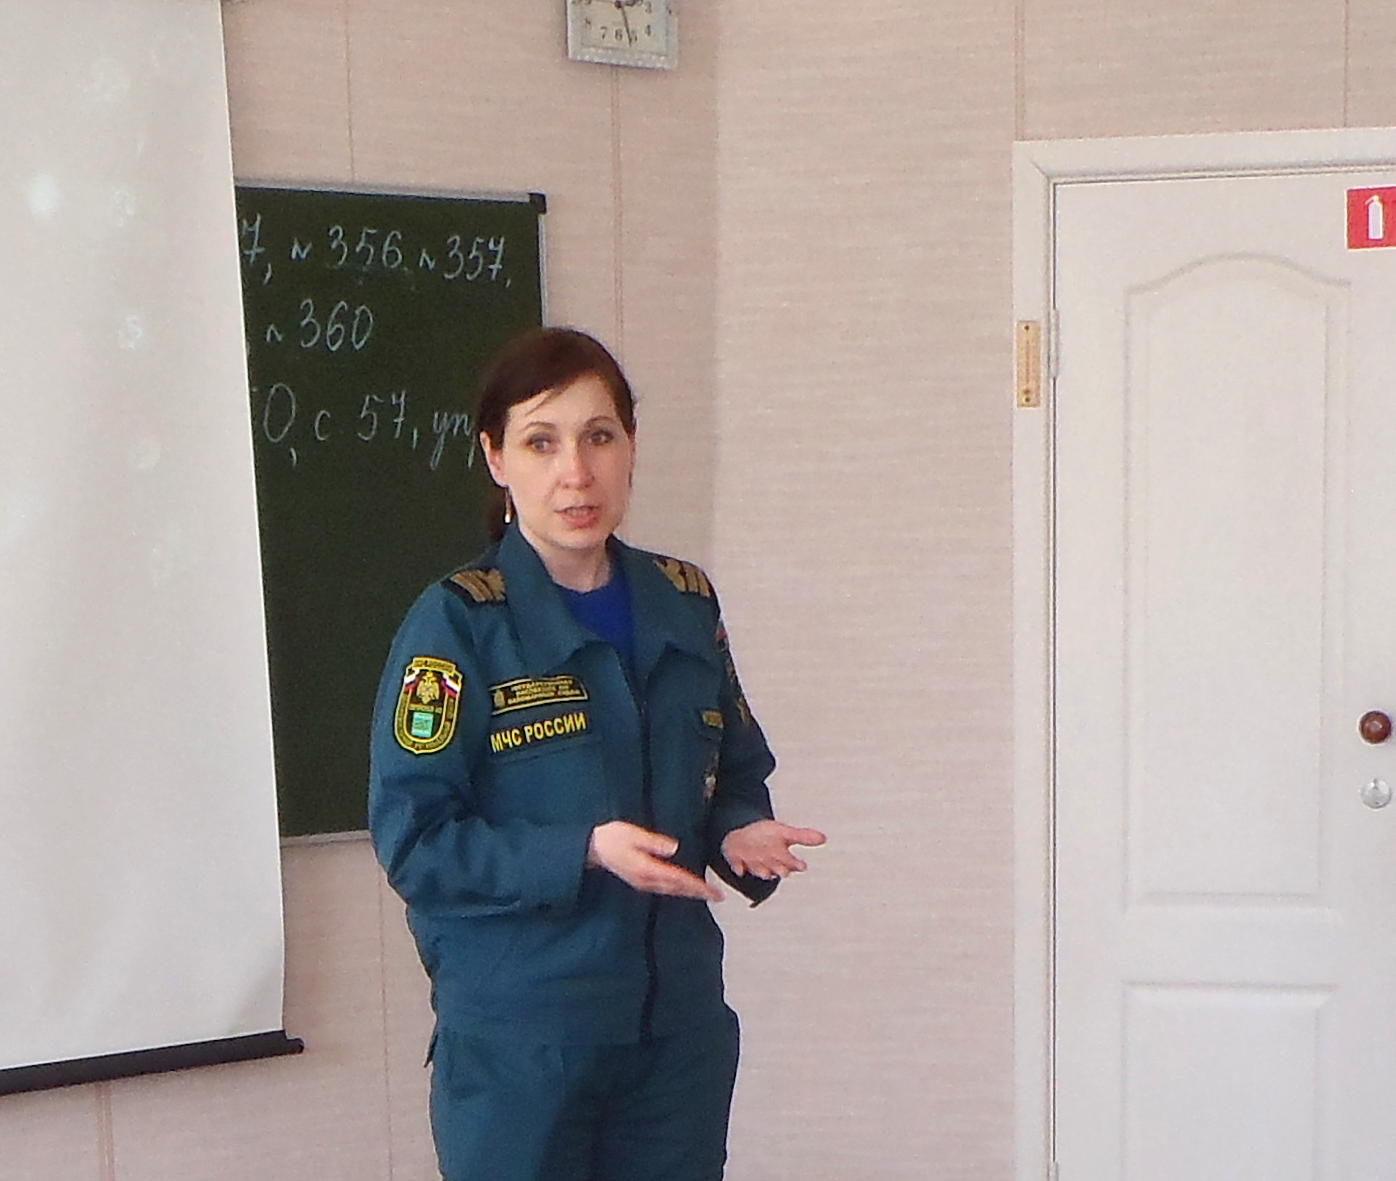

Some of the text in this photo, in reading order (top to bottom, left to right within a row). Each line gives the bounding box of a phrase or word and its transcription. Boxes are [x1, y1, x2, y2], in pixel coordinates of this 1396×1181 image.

[299, 298, 374, 352] 360
[490, 711, 588, 754] МЧС РОССИИ
